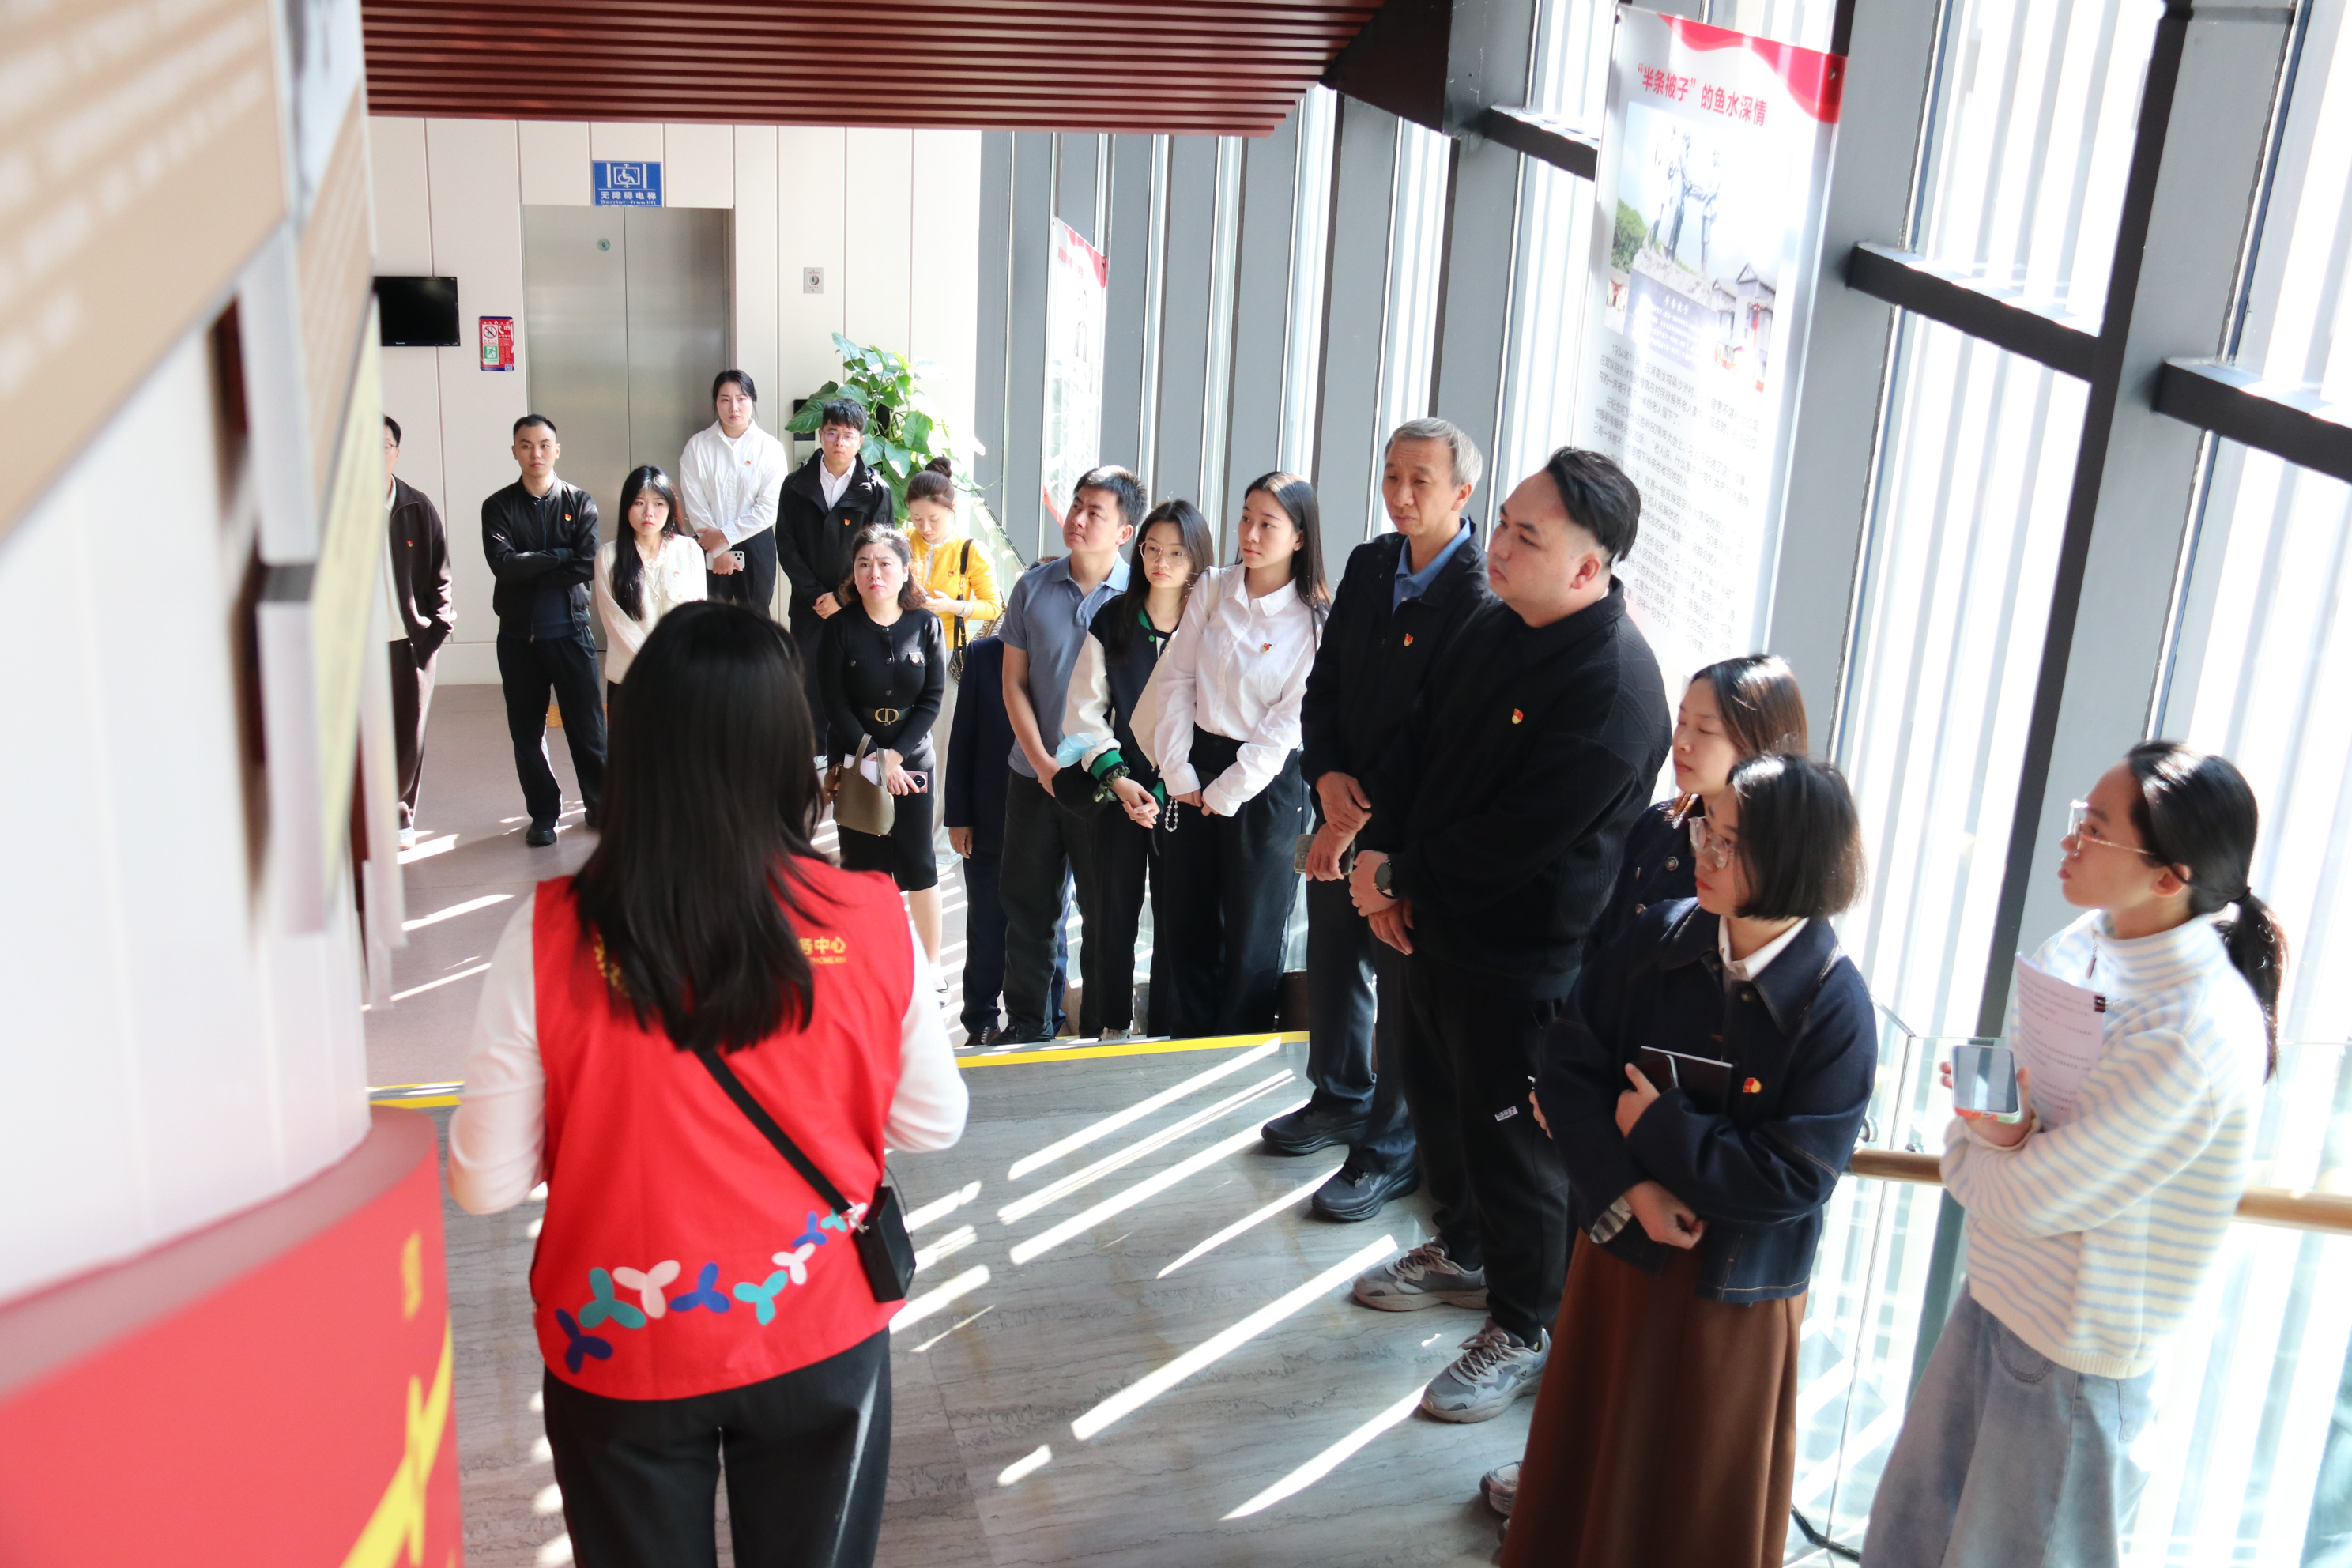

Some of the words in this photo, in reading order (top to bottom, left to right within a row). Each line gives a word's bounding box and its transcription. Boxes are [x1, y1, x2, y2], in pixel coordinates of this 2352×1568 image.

[1638, 63, 1767, 127] “半条被子”的鱼水深情
[600, 191, 657, 200] 无障碍电梯
